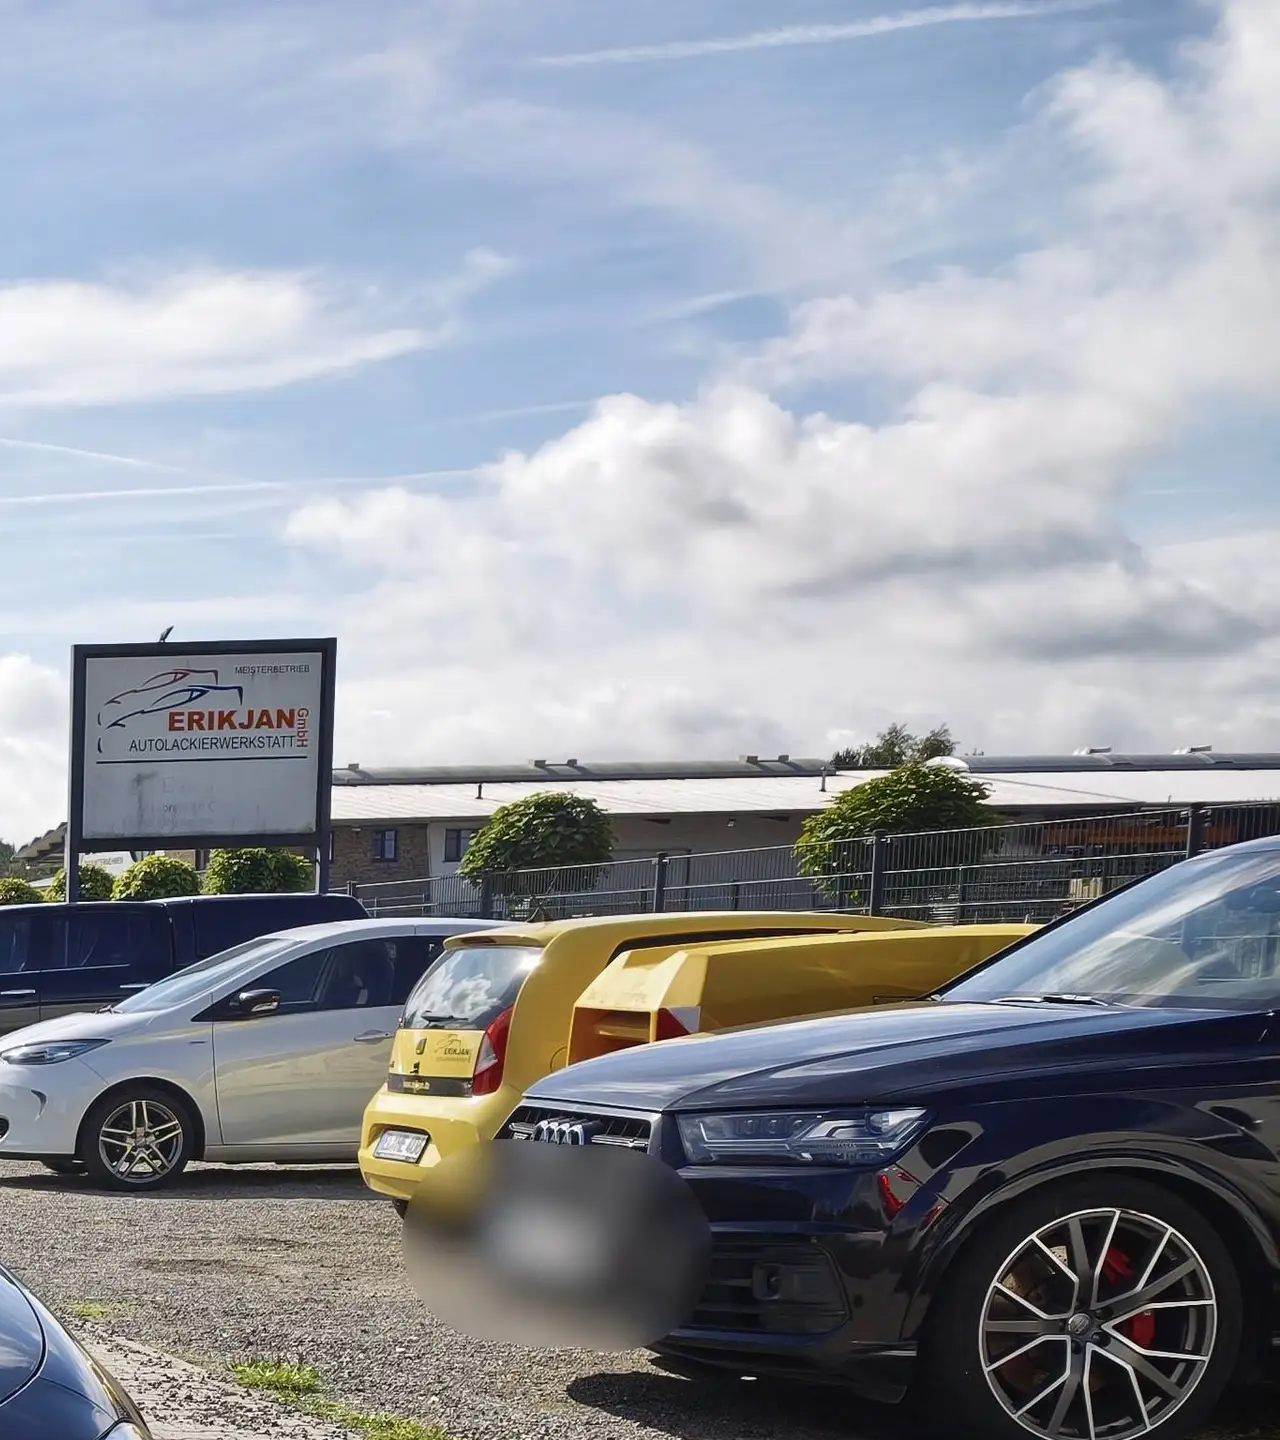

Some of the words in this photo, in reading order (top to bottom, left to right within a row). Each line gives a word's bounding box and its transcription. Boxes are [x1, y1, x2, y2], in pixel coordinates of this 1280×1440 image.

[234, 664, 310, 675] MEISTERBETRIEB
[168, 708, 295, 732] ERIKJAN
[296, 707, 309, 749] GmbH
[129, 735, 296, 752] AUTOLACKIERWERKSTATT
